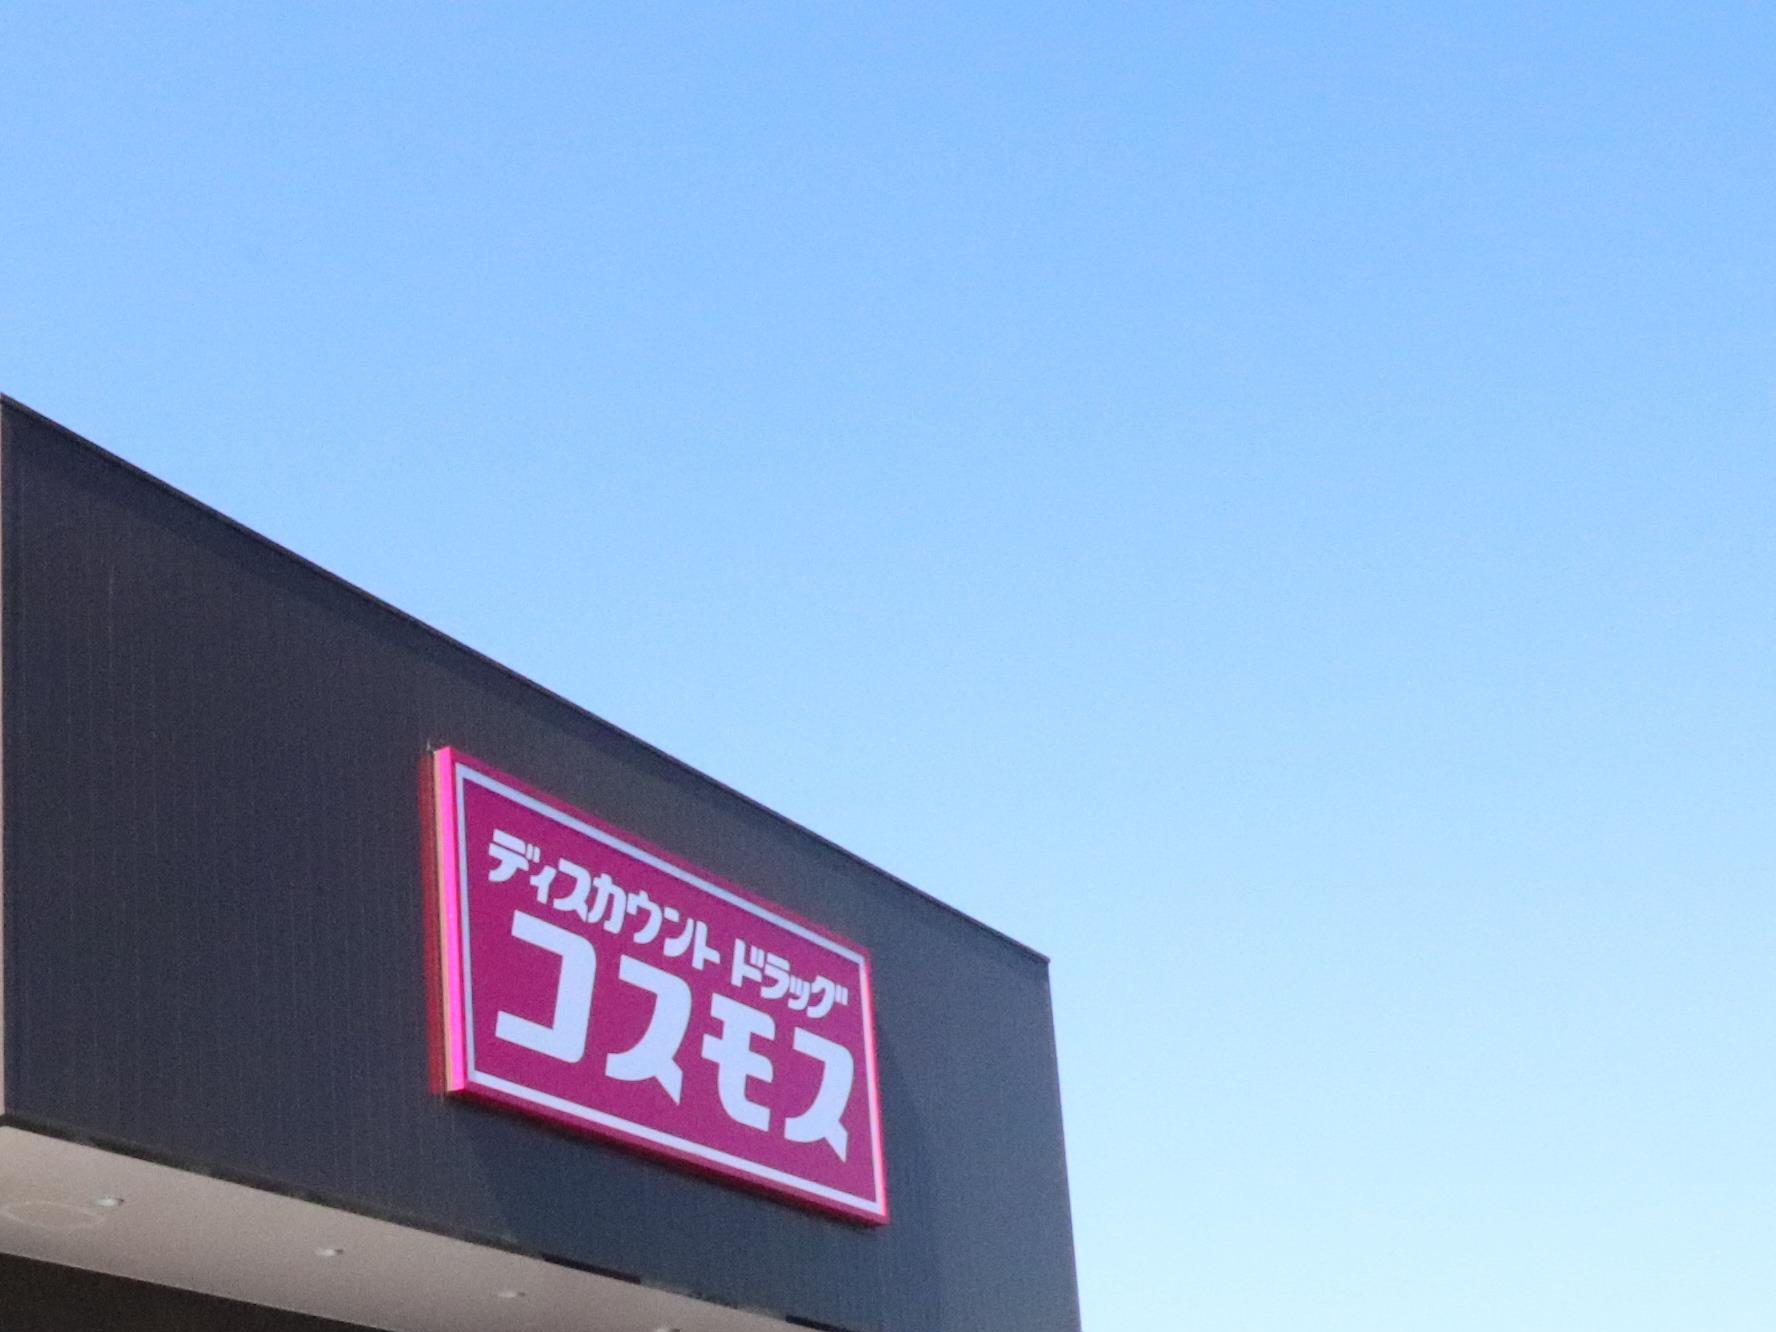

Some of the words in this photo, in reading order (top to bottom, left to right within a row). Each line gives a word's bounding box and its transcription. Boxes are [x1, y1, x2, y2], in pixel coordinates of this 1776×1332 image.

[488, 829, 720, 971] ディスカウント
[731, 937, 849, 1019] ドラッグ
[495, 909, 854, 1163] コスモス
